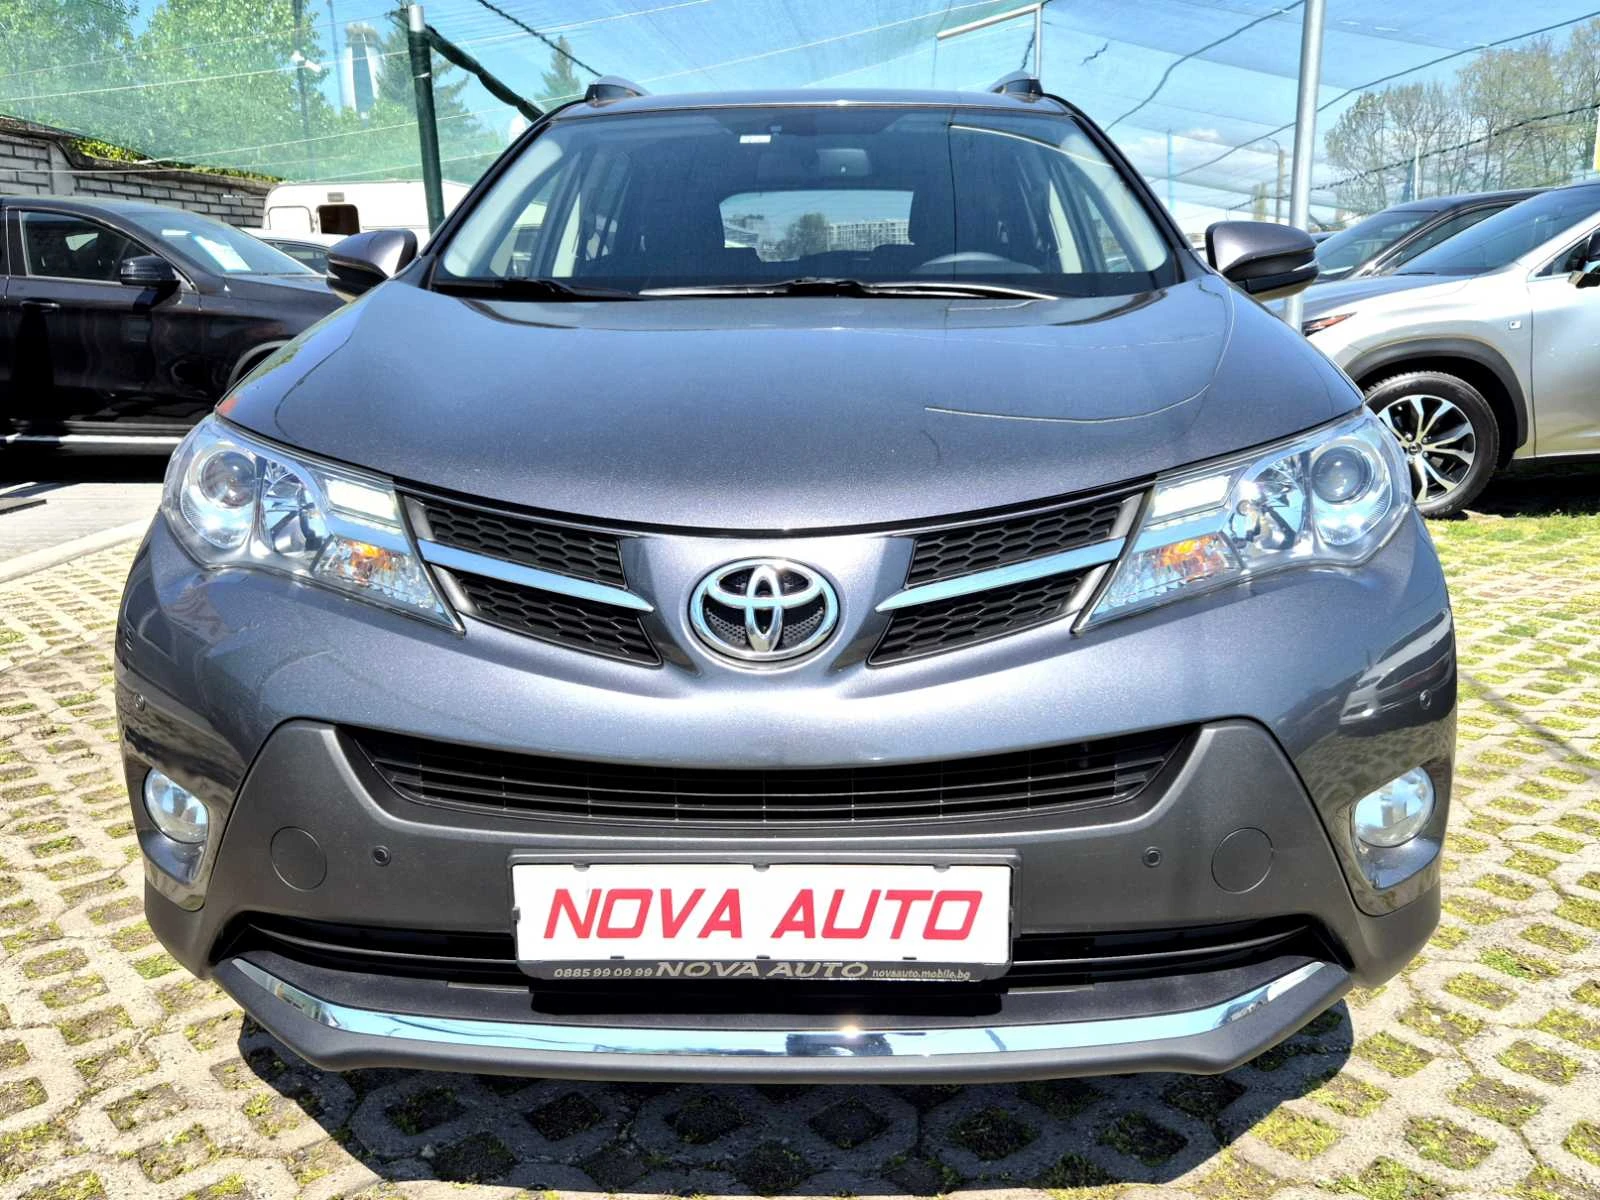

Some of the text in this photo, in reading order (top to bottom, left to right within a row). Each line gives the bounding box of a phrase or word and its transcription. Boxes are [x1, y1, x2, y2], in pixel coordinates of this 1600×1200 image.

[543, 888, 983, 940] NOVA AUTO
[553, 967, 653, 978] 0885 99 09 99
[655, 961, 869, 978] NOVA AUTO
[872, 969, 971, 981] novaauto.mobile.bg
